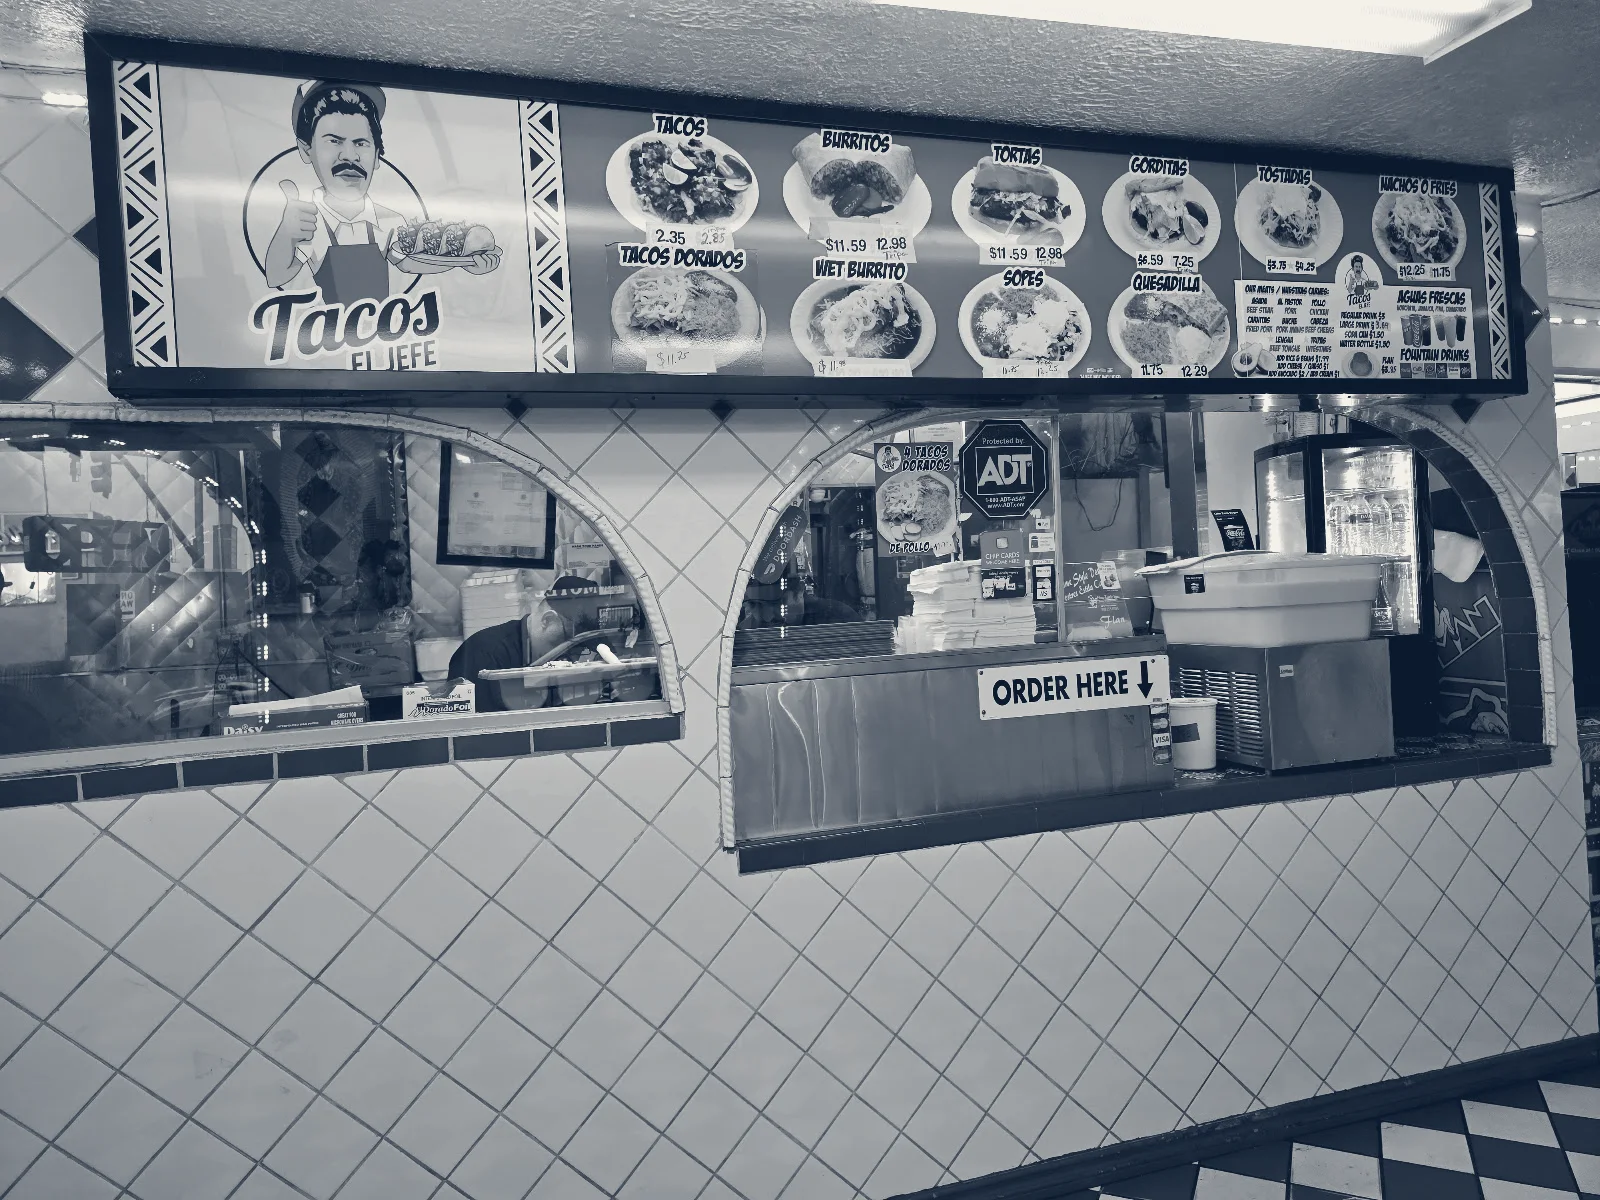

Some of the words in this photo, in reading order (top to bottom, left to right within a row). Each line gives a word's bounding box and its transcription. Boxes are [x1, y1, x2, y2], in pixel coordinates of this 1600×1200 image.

[655, 116, 705, 136] TACOS
[822, 130, 890, 152] BURRITOS
[994, 146, 1041, 164] TORTAS
[1130, 157, 1188, 176] GORDITAS
[1257, 166, 1311, 184] TOSTADAS
[1380, 175, 1418, 193] NACHOS
[1421, 178, 1428, 194] O
[1429, 180, 1456, 196] FRIES
[656, 229, 685, 245] 2.35
[701, 232, 725, 245] 2.85
[826, 237, 867, 252] $11.59
[876, 237, 906, 250] 12.98
[621, 245, 669, 265] TACOS
[673, 247, 744, 269] DORADOS
[990, 246, 1027, 260] $11.59
[1035, 246, 1063, 259] 12.98
[1173, 255, 1194, 267] 7.25
[1267, 259, 1286, 271] $3.75
[815, 259, 846, 277] WET
[847, 261, 905, 279] BURRITO
[1399, 264, 1425, 277] $12.25
[1003, 270, 1044, 287] SOPES
[1132, 273, 1201, 292] QUESADILLA
[1245, 285, 1256, 293] OUR
[1311, 299, 1326, 307] POLLO
[1347, 293, 1370, 306] Tacos
[1397, 290, 1427, 304] AGUAS
[1429, 291, 1465, 305] FRESCAS
[1310, 308, 1329, 316] CHICKEN
[253, 290, 440, 361] Tacos
[1355, 321, 1370, 329] DRINK
[1340, 340, 1356, 348] WATER
[386, 340, 437, 370] JEFE
[1400, 348, 1439, 361] FOUNTAIN
[1441, 348, 1470, 361] DRINKS
[982, 437, 1014, 445] Protected
[904, 446, 911, 458] 4
[915, 445, 948, 458] TACOS
[902, 459, 950, 471] DORADOS
[978, 453, 1032, 486] ADT
[773, 515, 802, 562] DOORDASH
[889, 543, 901, 553] DE
[903, 542, 930, 552] POLLO
[1100, 616, 1125, 629] Flan
[992, 676, 1068, 706] ORDER
[1076, 670, 1129, 698] HERE
[223, 723, 264, 735] Daisy
